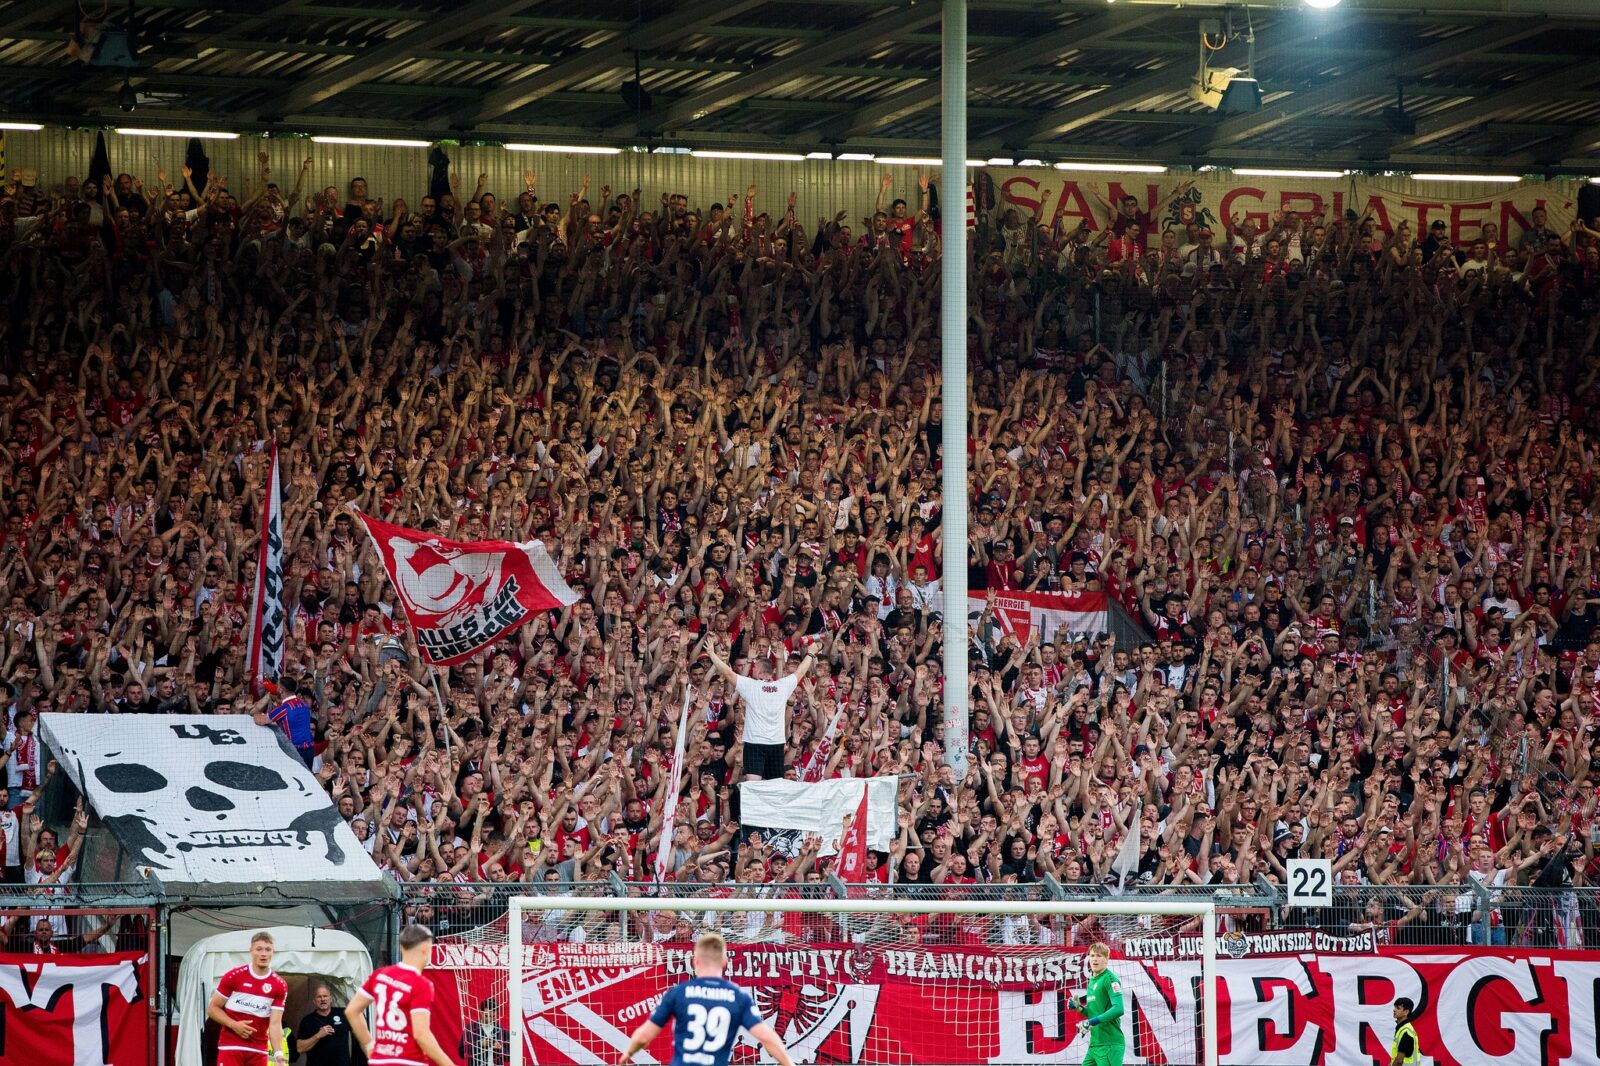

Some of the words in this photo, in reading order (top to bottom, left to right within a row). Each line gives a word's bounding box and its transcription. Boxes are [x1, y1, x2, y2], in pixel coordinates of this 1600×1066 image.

[1001, 176, 1160, 236] SAN
[993, 598, 1025, 610] ENERGIE
[418, 615, 478, 647] ALLES
[427, 597, 526, 662] ENERGIE!
[1293, 867, 1327, 897] 22
[558, 943, 583, 954] EHRE
[585, 943, 606, 954] DER
[1178, 934, 1229, 956] JUGND
[1248, 932, 1312, 954] FRONTSIDE
[1315, 932, 1371, 952] COTTBUS
[374, 983, 408, 1031] 16
[617, 991, 667, 1023] COTTBU
[683, 1003, 731, 1052] 39
